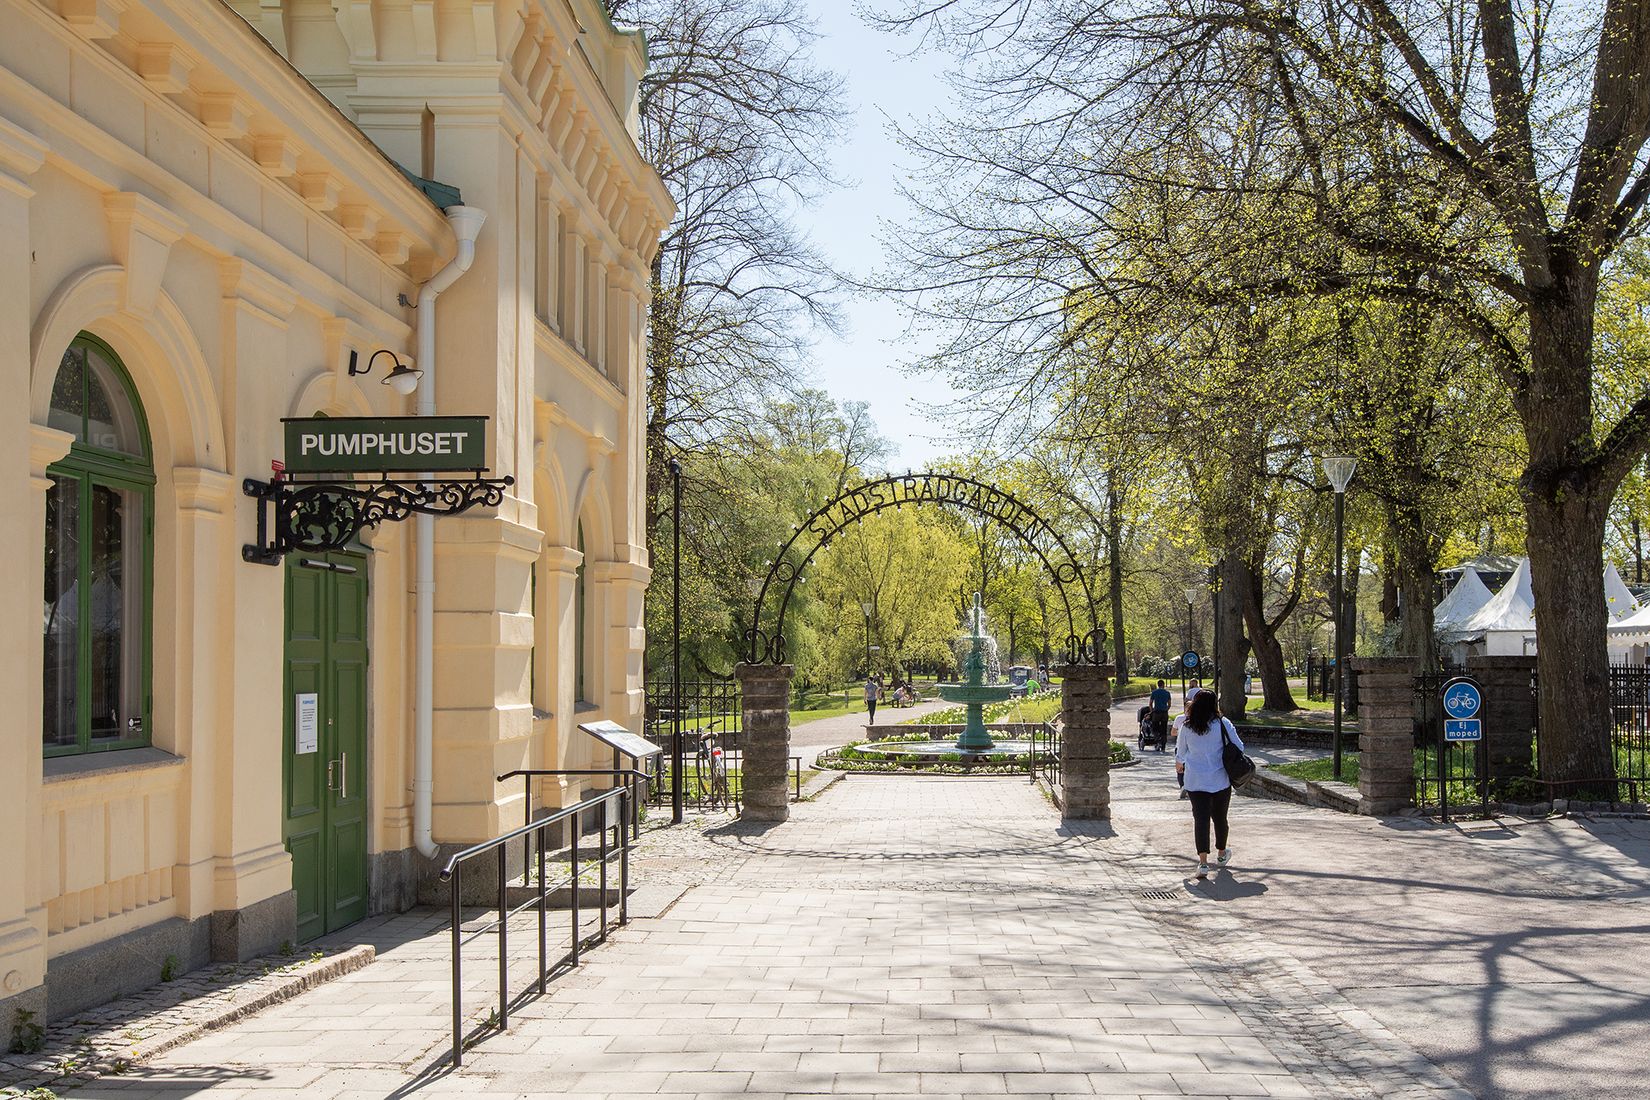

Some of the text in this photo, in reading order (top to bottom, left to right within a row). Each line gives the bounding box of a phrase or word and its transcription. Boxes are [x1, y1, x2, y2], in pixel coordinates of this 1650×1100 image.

[301, 432, 468, 456] PUMPHUSET
[1458, 722, 1467, 730] Ej
[1449, 730, 1478, 738] moped
